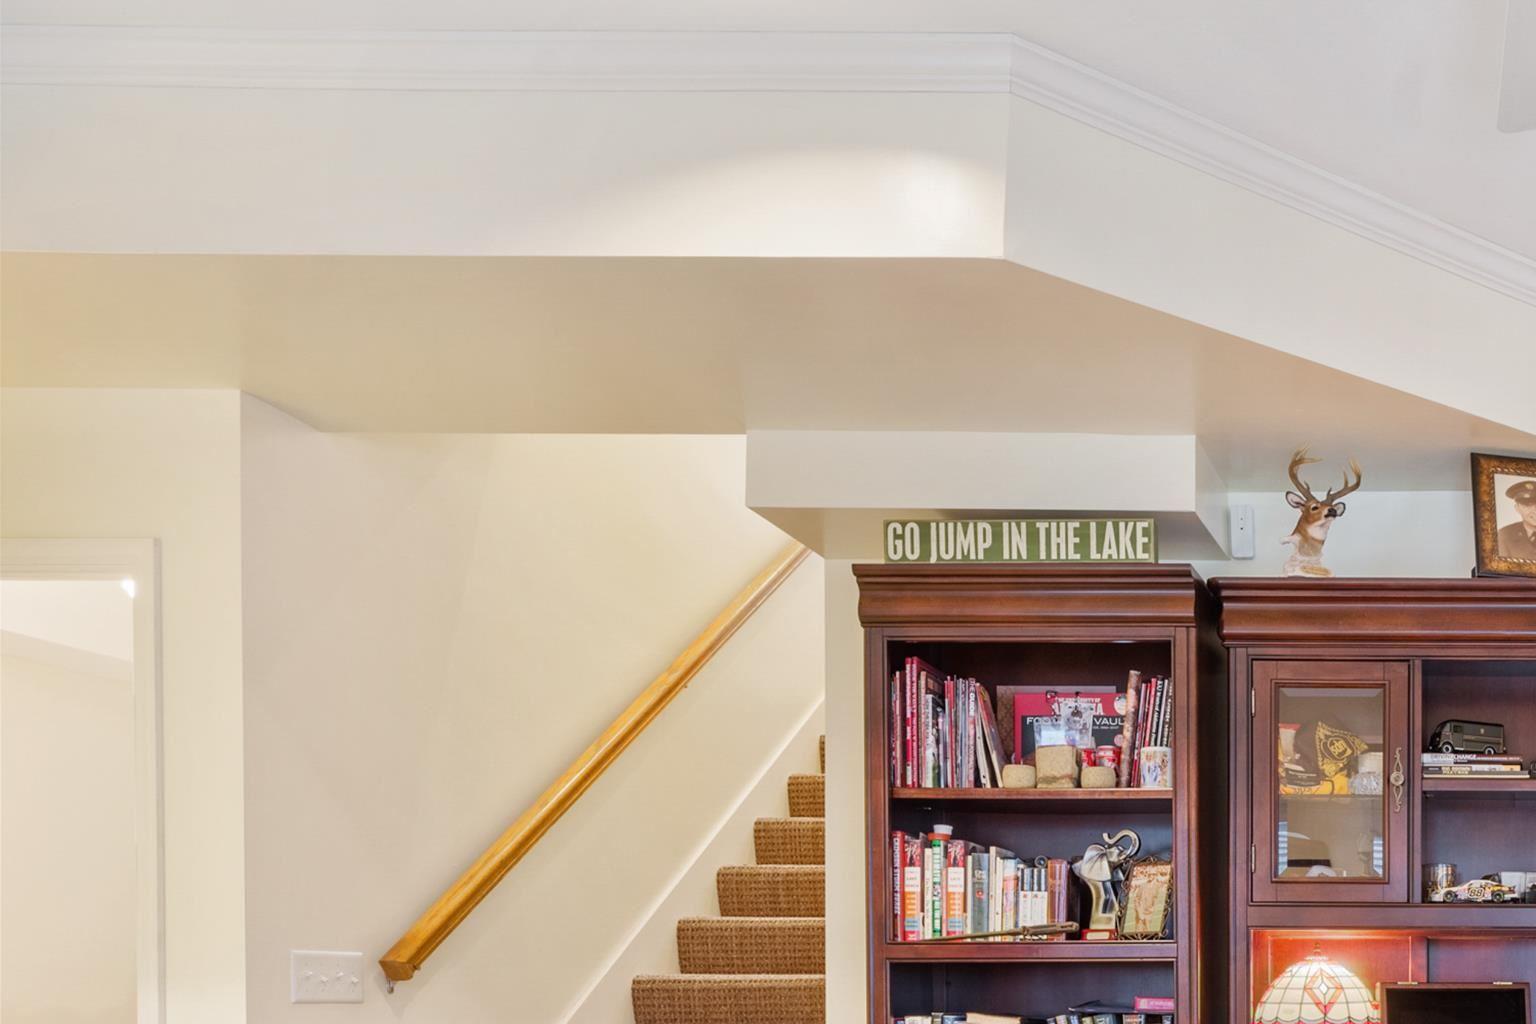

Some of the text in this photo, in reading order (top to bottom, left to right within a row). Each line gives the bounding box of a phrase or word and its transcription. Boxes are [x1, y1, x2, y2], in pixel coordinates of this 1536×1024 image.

[887, 521, 1149, 563] GO JUMP IN THE LAKE
[1094, 717, 1124, 725] VAUL
